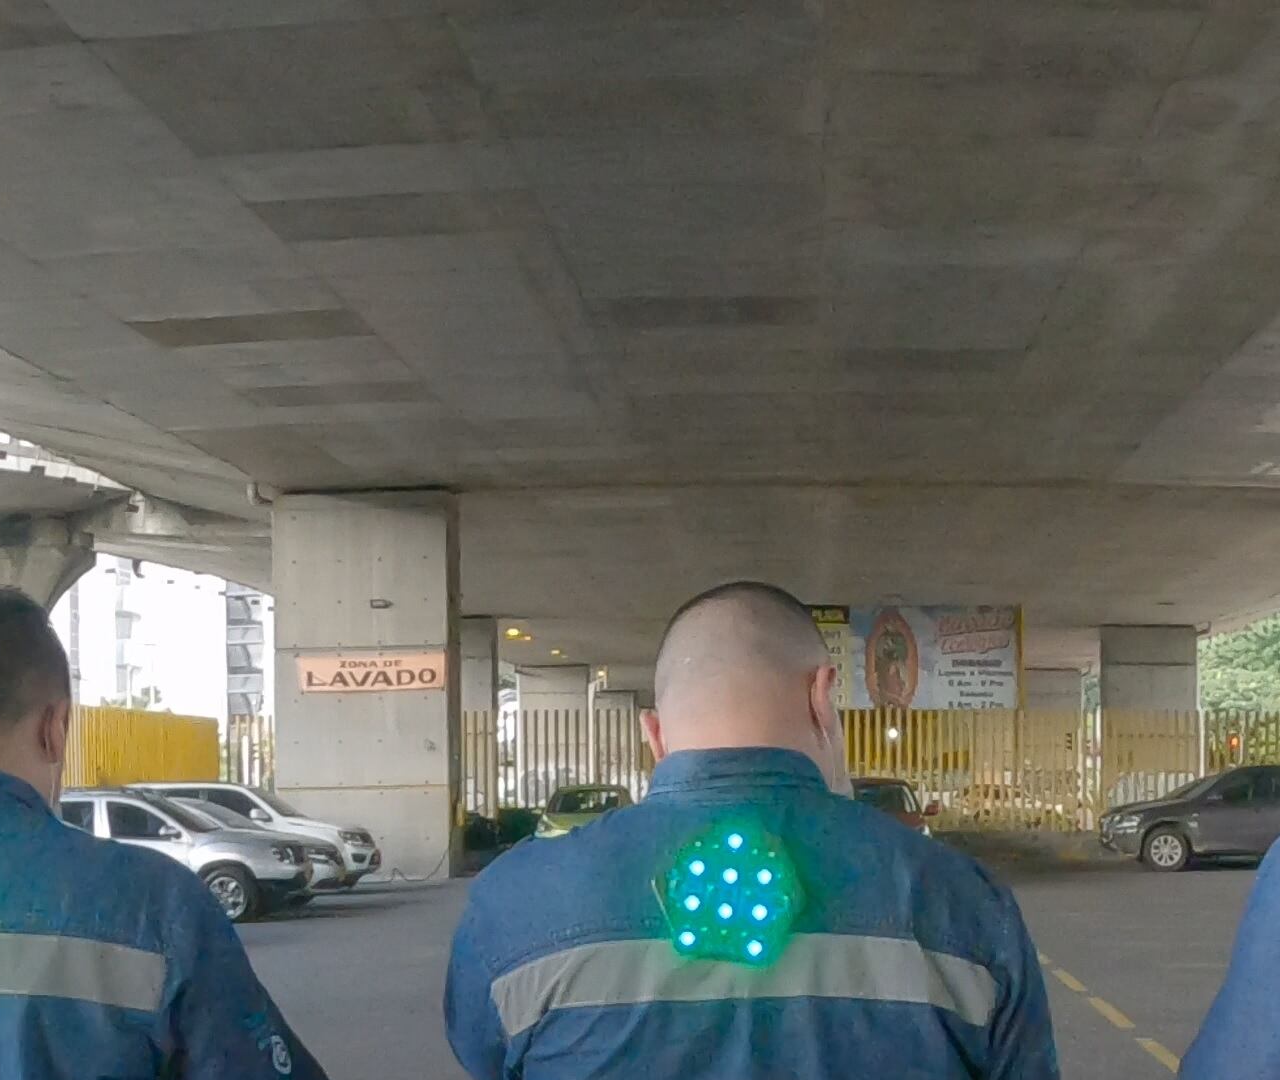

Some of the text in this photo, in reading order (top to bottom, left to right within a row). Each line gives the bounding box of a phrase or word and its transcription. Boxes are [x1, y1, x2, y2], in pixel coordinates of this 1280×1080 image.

[339, 659, 403, 669] ZONA DE
[306, 668, 437, 687] LAVADO
